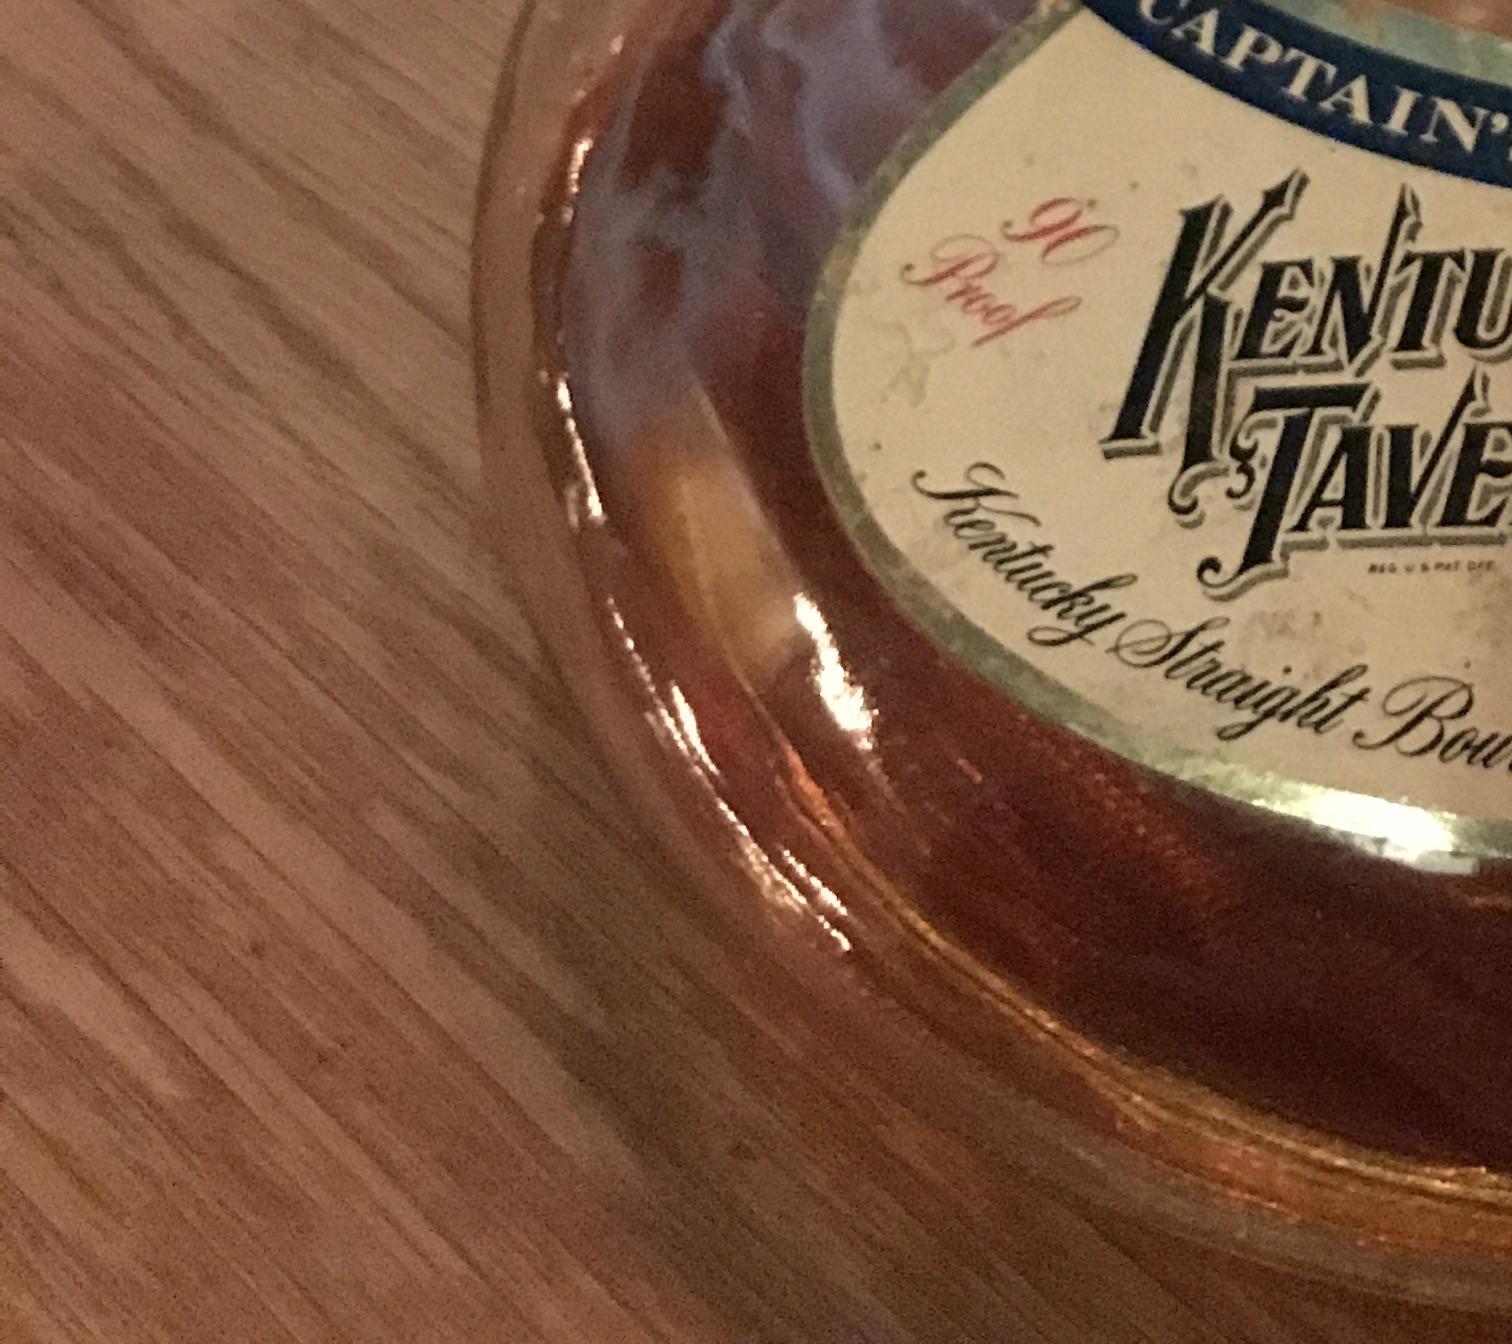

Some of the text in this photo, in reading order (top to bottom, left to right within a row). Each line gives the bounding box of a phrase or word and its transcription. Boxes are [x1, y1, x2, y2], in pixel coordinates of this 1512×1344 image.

[1002, 197, 1120, 267] 90
[903, 233, 1084, 349] Proof
[911, 461, 1137, 648] Kentucky
[1107, 616, 1371, 740] Straight
